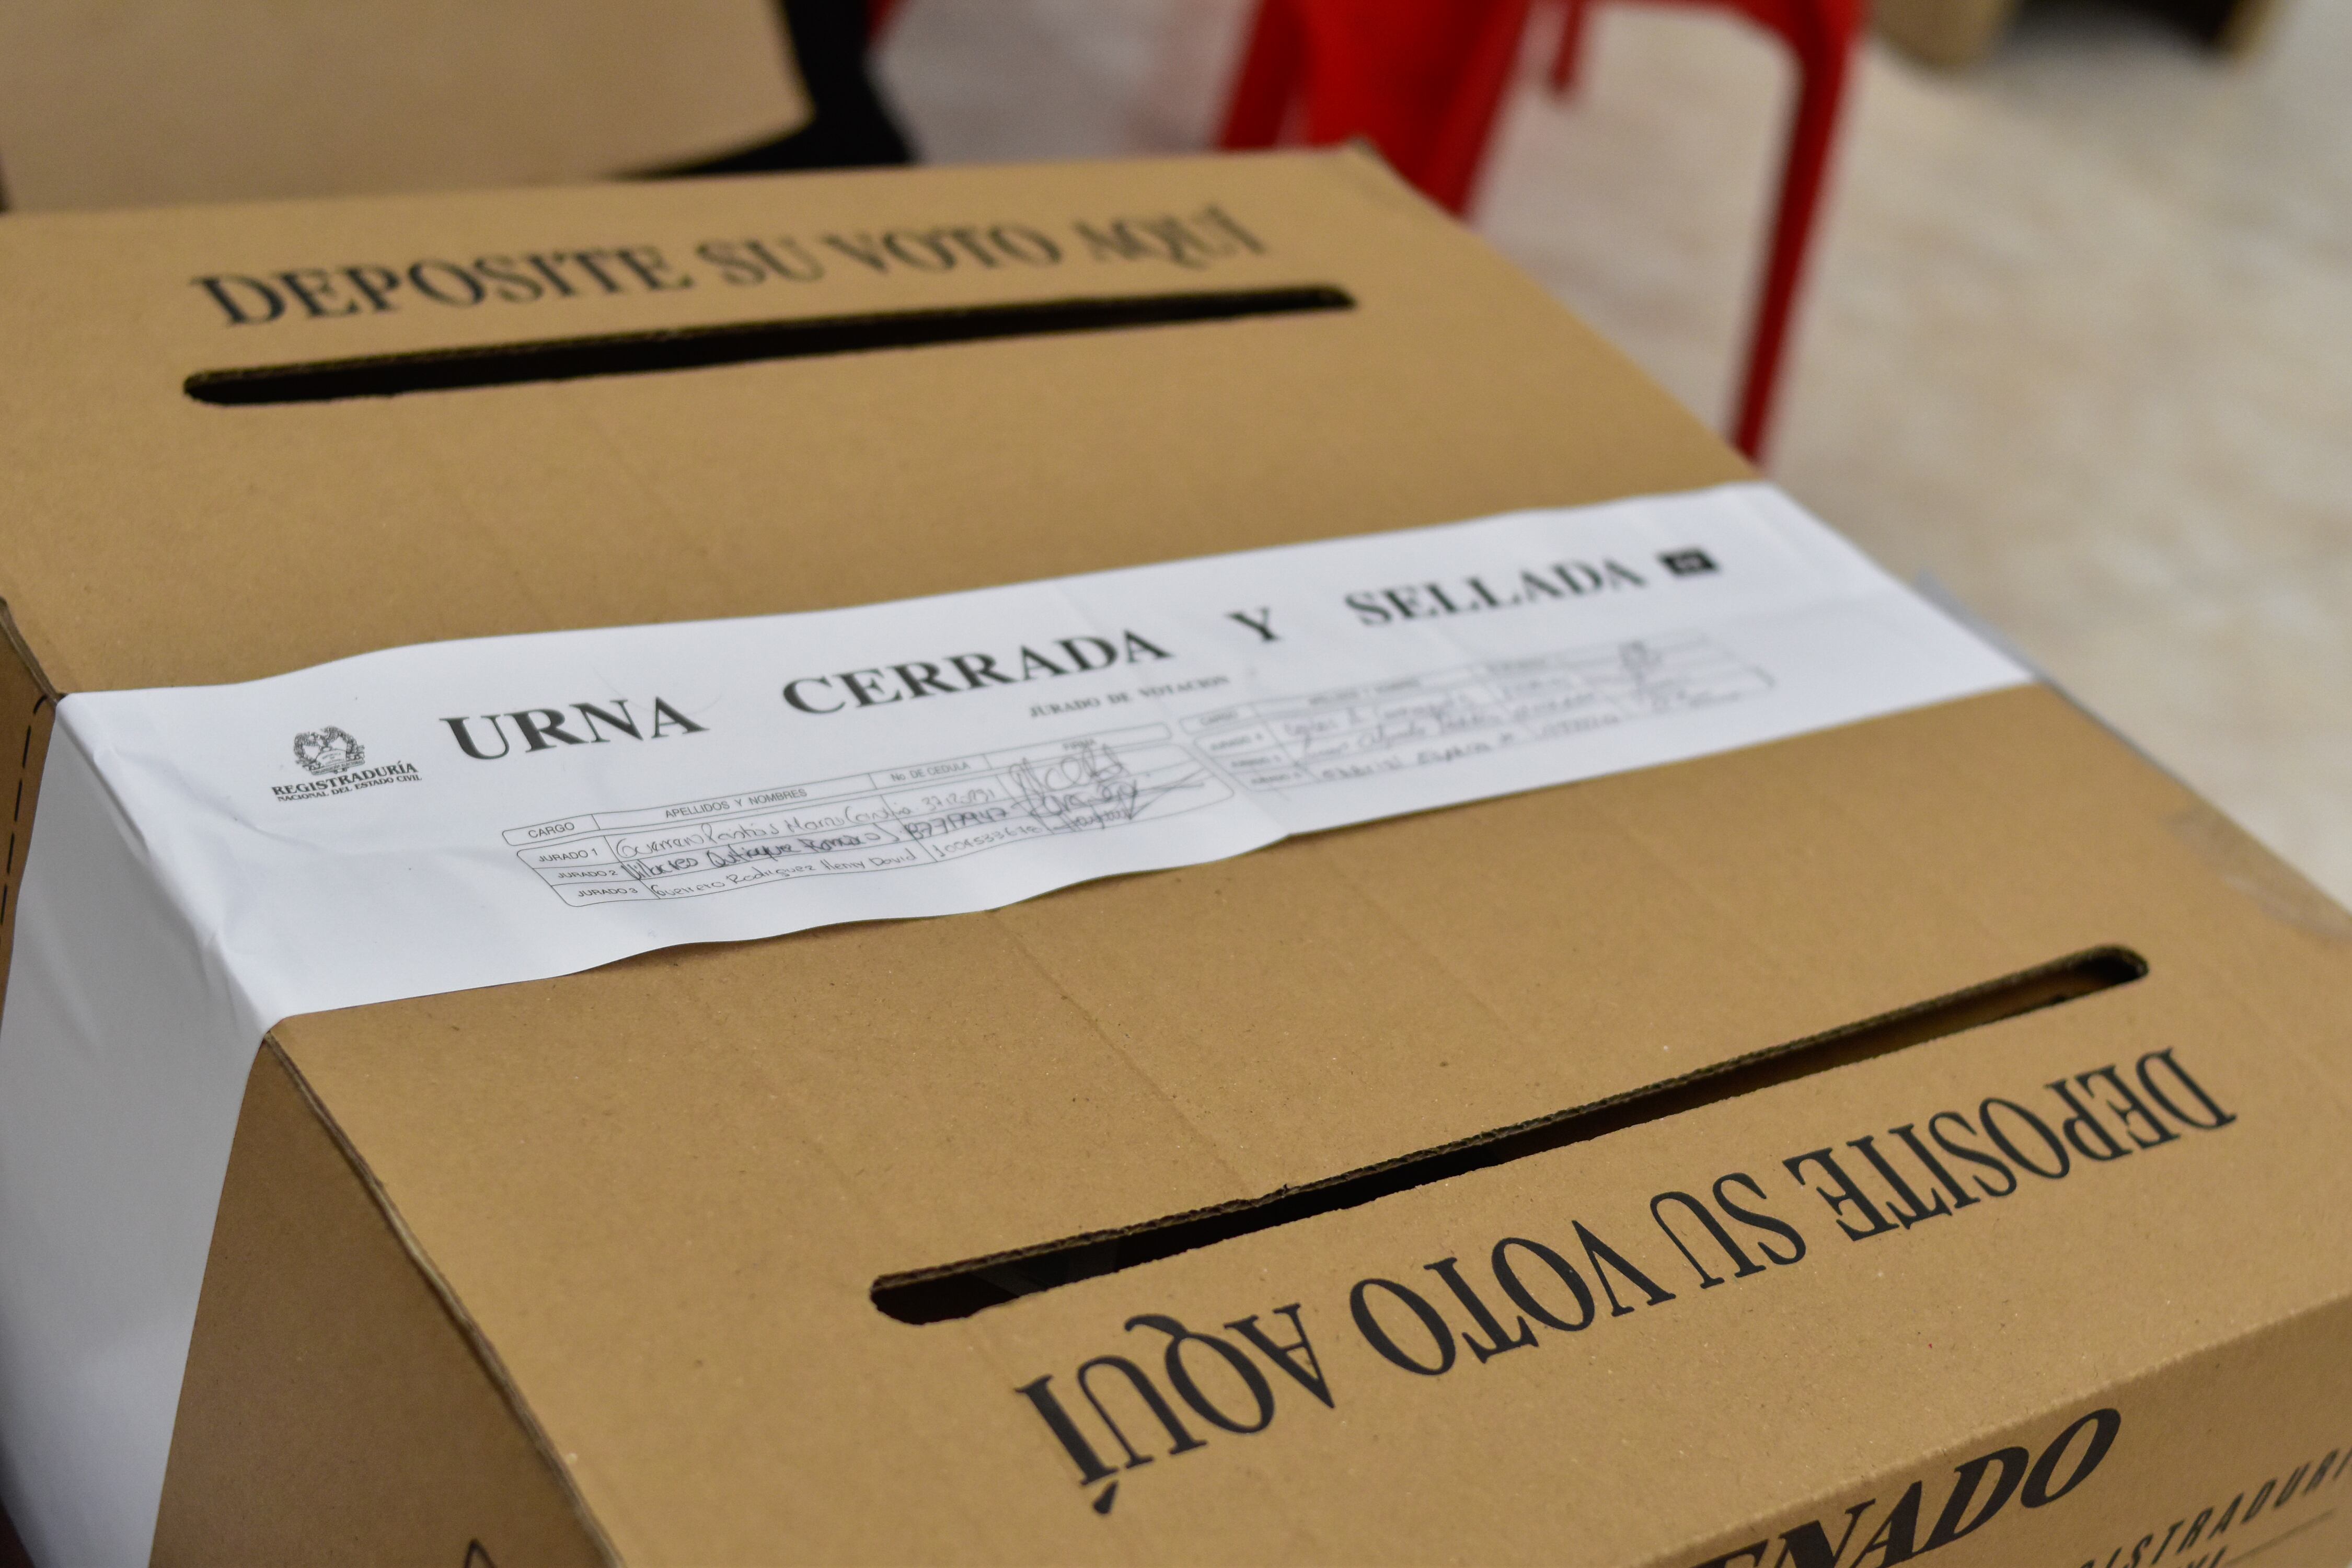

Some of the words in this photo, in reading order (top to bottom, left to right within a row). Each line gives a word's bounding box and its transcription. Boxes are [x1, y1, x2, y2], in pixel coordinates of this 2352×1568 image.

[191, 246, 694, 327] DEPOSITE
[696, 238, 825, 286] SU
[821, 224, 1062, 274] VOTO
[1071, 203, 1267, 270] AQUÍ
[439, 694, 710, 760] URNA
[782, 628, 1173, 716] CERRADA
[1226, 606, 1281, 643] Y
[1344, 557, 1647, 627] SELLADA
[1030, 697, 1101, 718] JURADO
[1106, 691, 1131, 705] DE
[271, 760, 419, 796] REGISTRADURÍA
[277, 790, 330, 802] NACIONAL
[331, 786, 353, 795] DEL
[355, 776, 394, 791] ESTADO
[396, 774, 422, 782] CIVIL
[528, 822, 575, 838] CARGO
[665, 802, 731, 819] APELLIDOS
[734, 798, 743, 808] Y
[748, 788, 808, 805] NOMBRES
[910, 770, 924, 779] DE
[927, 762, 971, 775] CEDULA
[538, 849, 589, 863] JURADO
[591, 847, 598, 857] 1
[578, 888, 627, 897] JURADO
[869, 847, 916, 867] David
[1782, 1047, 2237, 1242] DEPOSITE
[1650, 1172, 1806, 1289] SU
[1350, 1219, 1677, 1376] VOTO
[1015, 1302, 1334, 1515] AQUÍ
